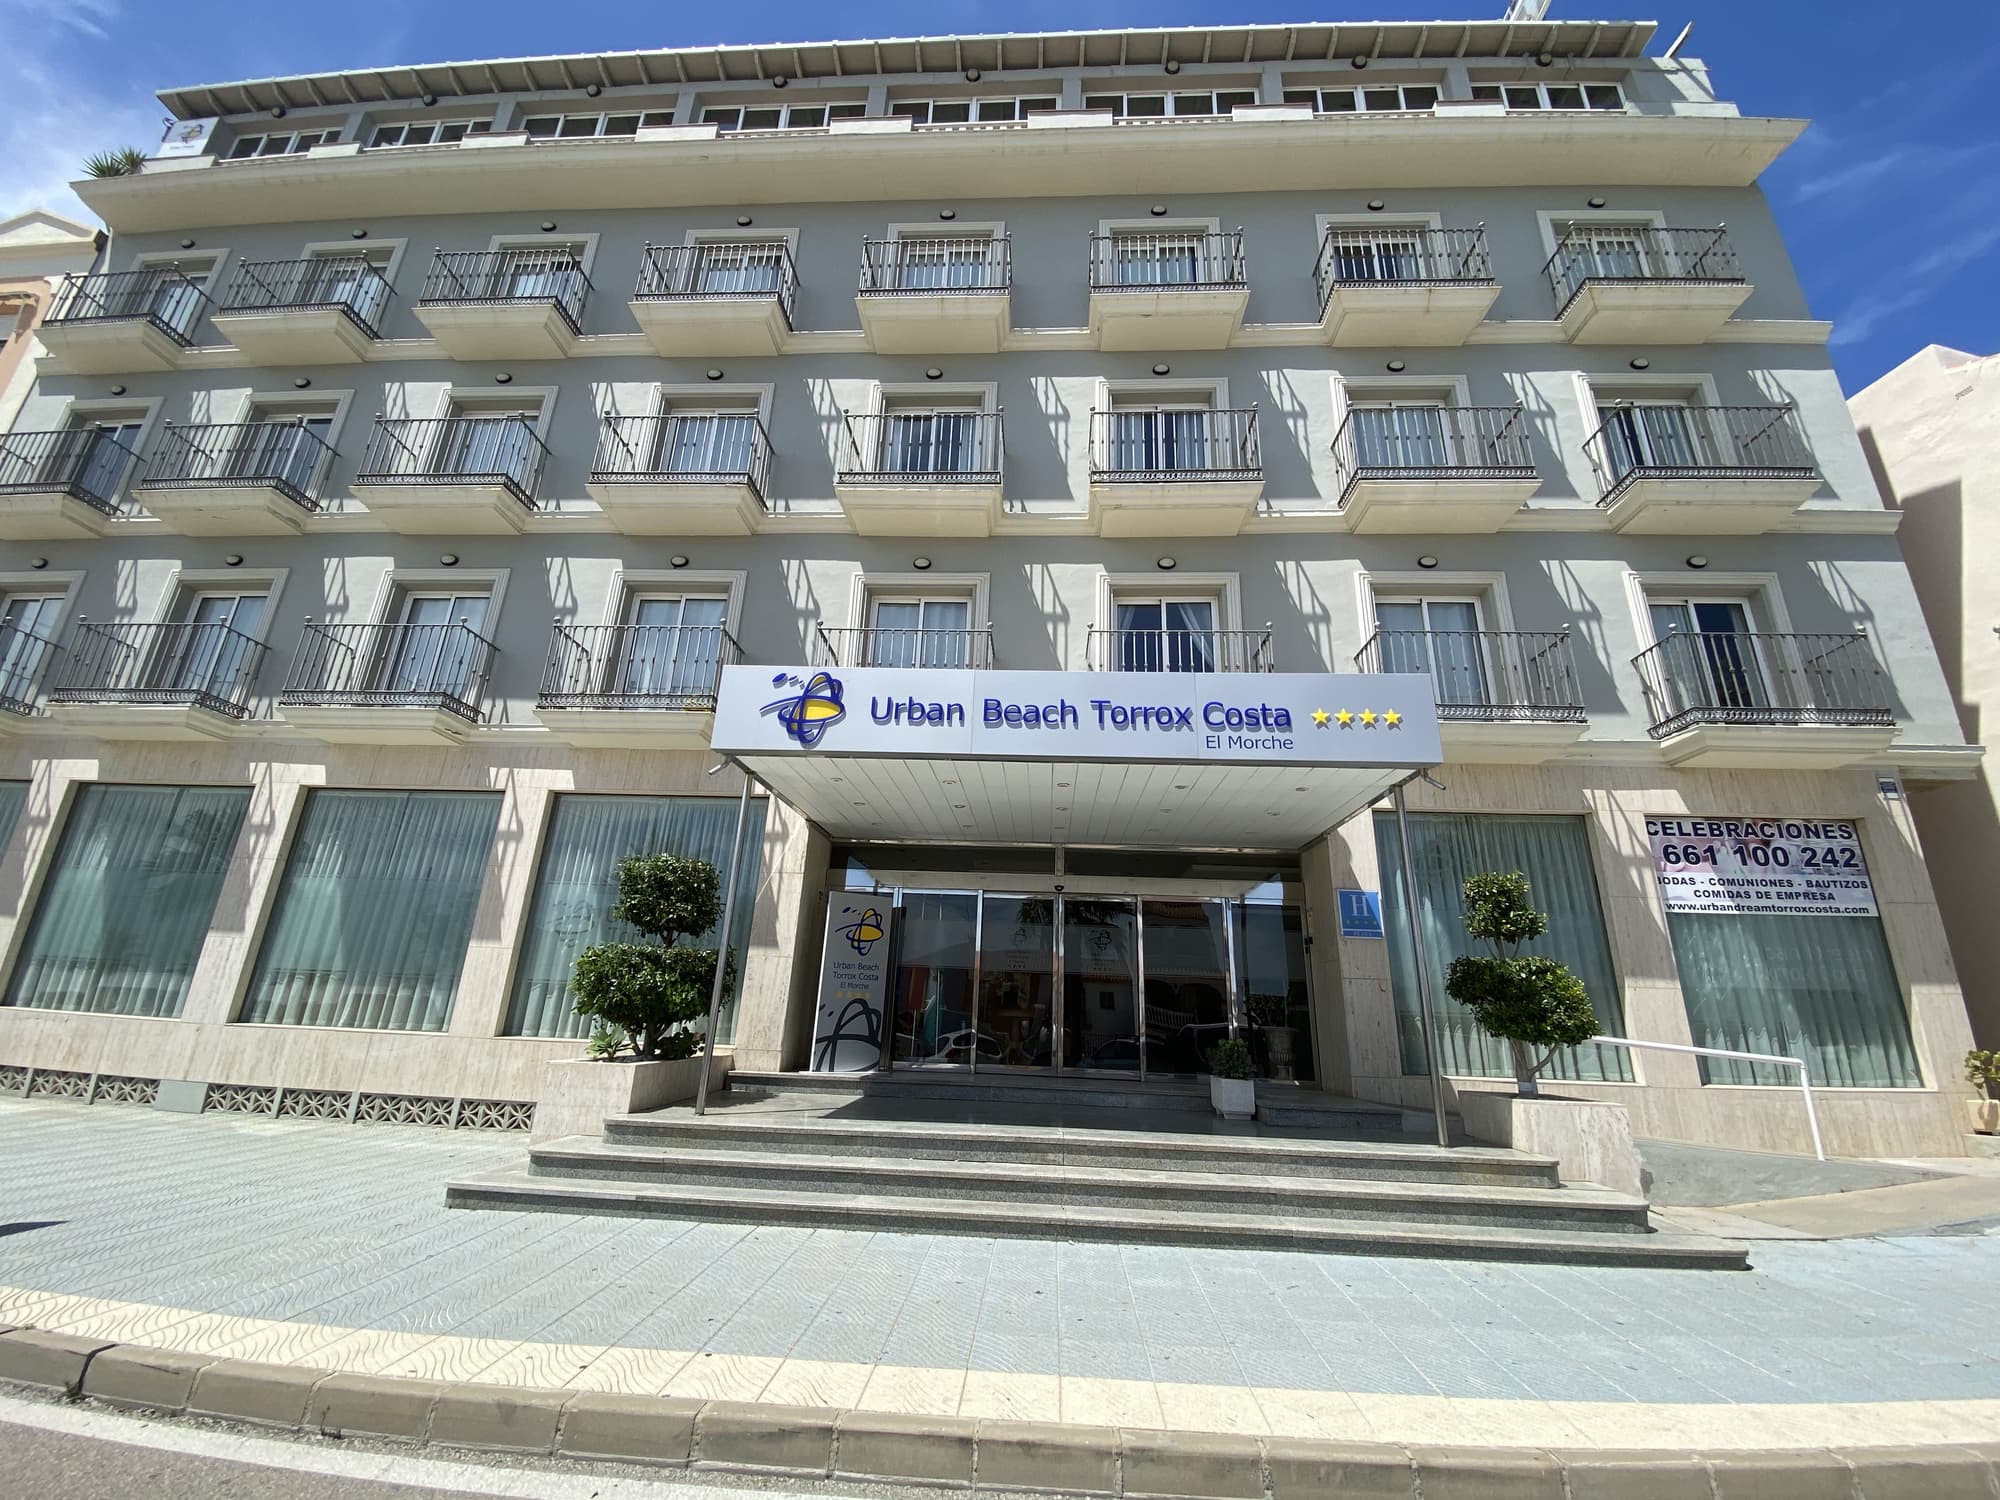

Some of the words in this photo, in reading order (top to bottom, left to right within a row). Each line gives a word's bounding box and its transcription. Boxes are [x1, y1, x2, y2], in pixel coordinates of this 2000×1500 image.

[870, 696, 965, 723] Urban
[982, 698, 1078, 725] Beach
[1090, 699, 1192, 727] Torrox
[1202, 701, 1292, 729] Costa
[1205, 735, 1221, 749] El
[1228, 735, 1294, 750] Morche
[1646, 820, 1853, 840] CELEBRACIONES
[1662, 844, 1718, 866] 661
[1732, 845, 1790, 868] 100
[1800, 846, 1860, 868] 242
[1708, 877, 1794, 889] COMUNIONES
[1806, 879, 1868, 890] BAUTIZOS
[1693, 889, 1751, 899] COMIDAS
[1755, 890, 1773, 900] DE
[1776, 891, 1836, 901] EMPRESA
[1348, 894, 1371, 917] H
[1665, 902, 1870, 914] www.urbandreamtorroxcosta.com
[833, 961, 856, 970] Urban
[857, 962, 880, 971] Beach
[858, 972, 879, 981] Costa
